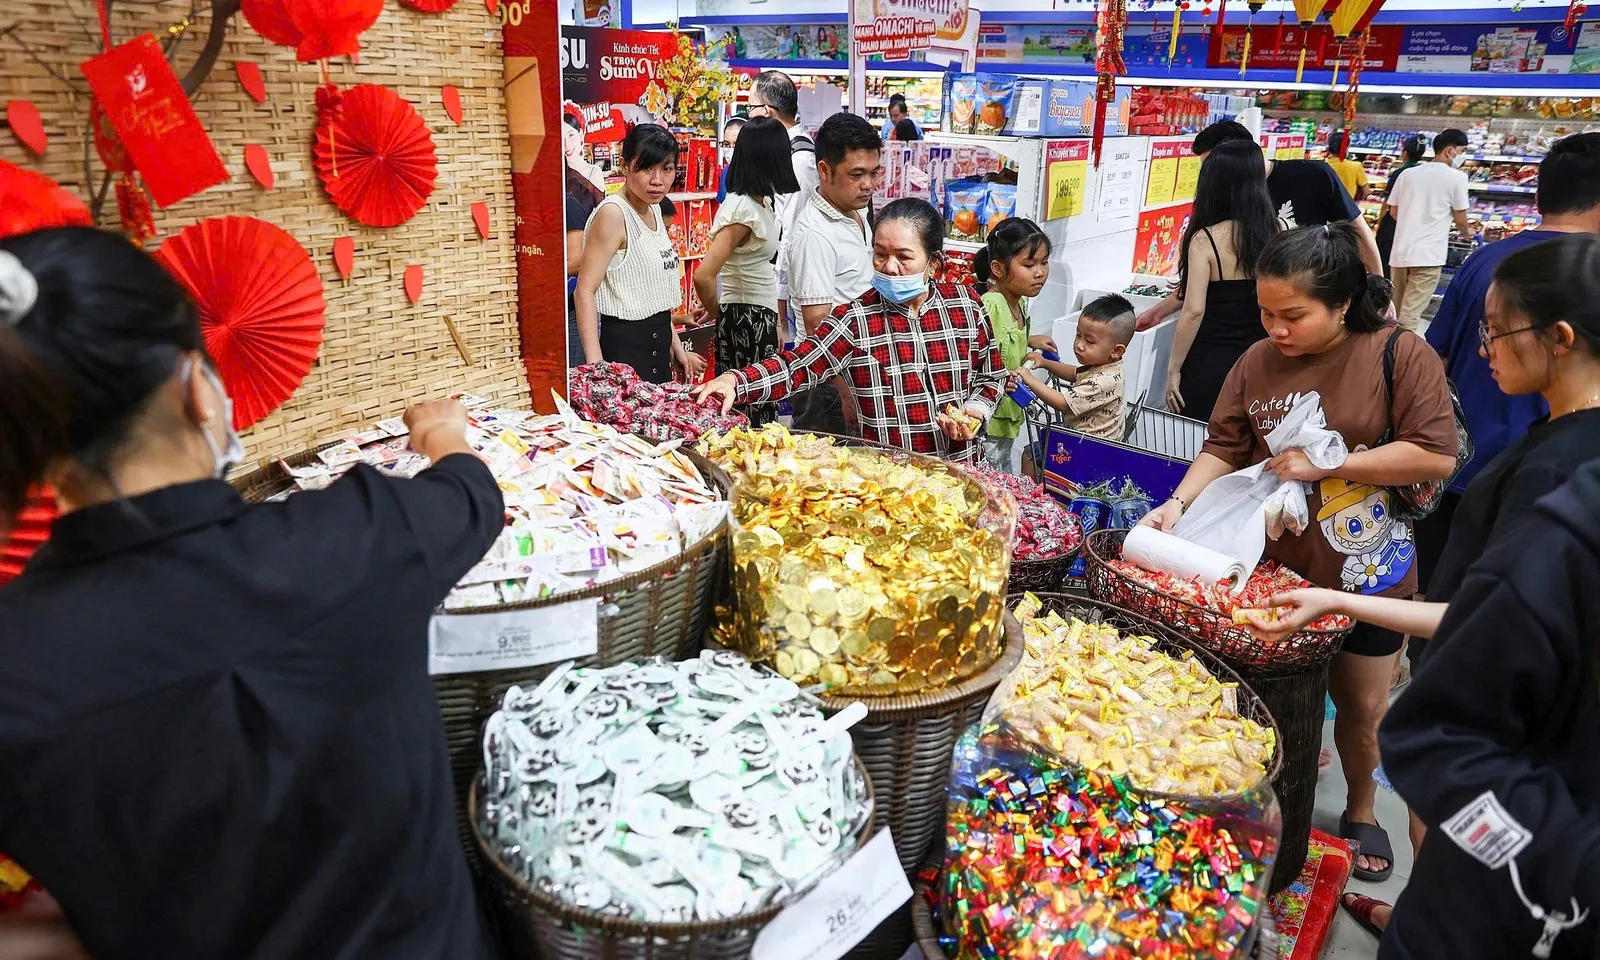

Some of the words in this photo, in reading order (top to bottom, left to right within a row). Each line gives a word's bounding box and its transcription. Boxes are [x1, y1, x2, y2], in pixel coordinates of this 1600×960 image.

[855, 25, 874, 37] MANG
[875, 19, 914, 36] OMACHI
[613, 42, 630, 53] Kính
[631, 45, 647, 55] chúc
[648, 44, 660, 55] Tết
[860, 42, 879, 53] MANG
[613, 56, 636, 66] TRỌN
[600, 55, 638, 80] Sum
[1050, 454, 1072, 465] Tiger
